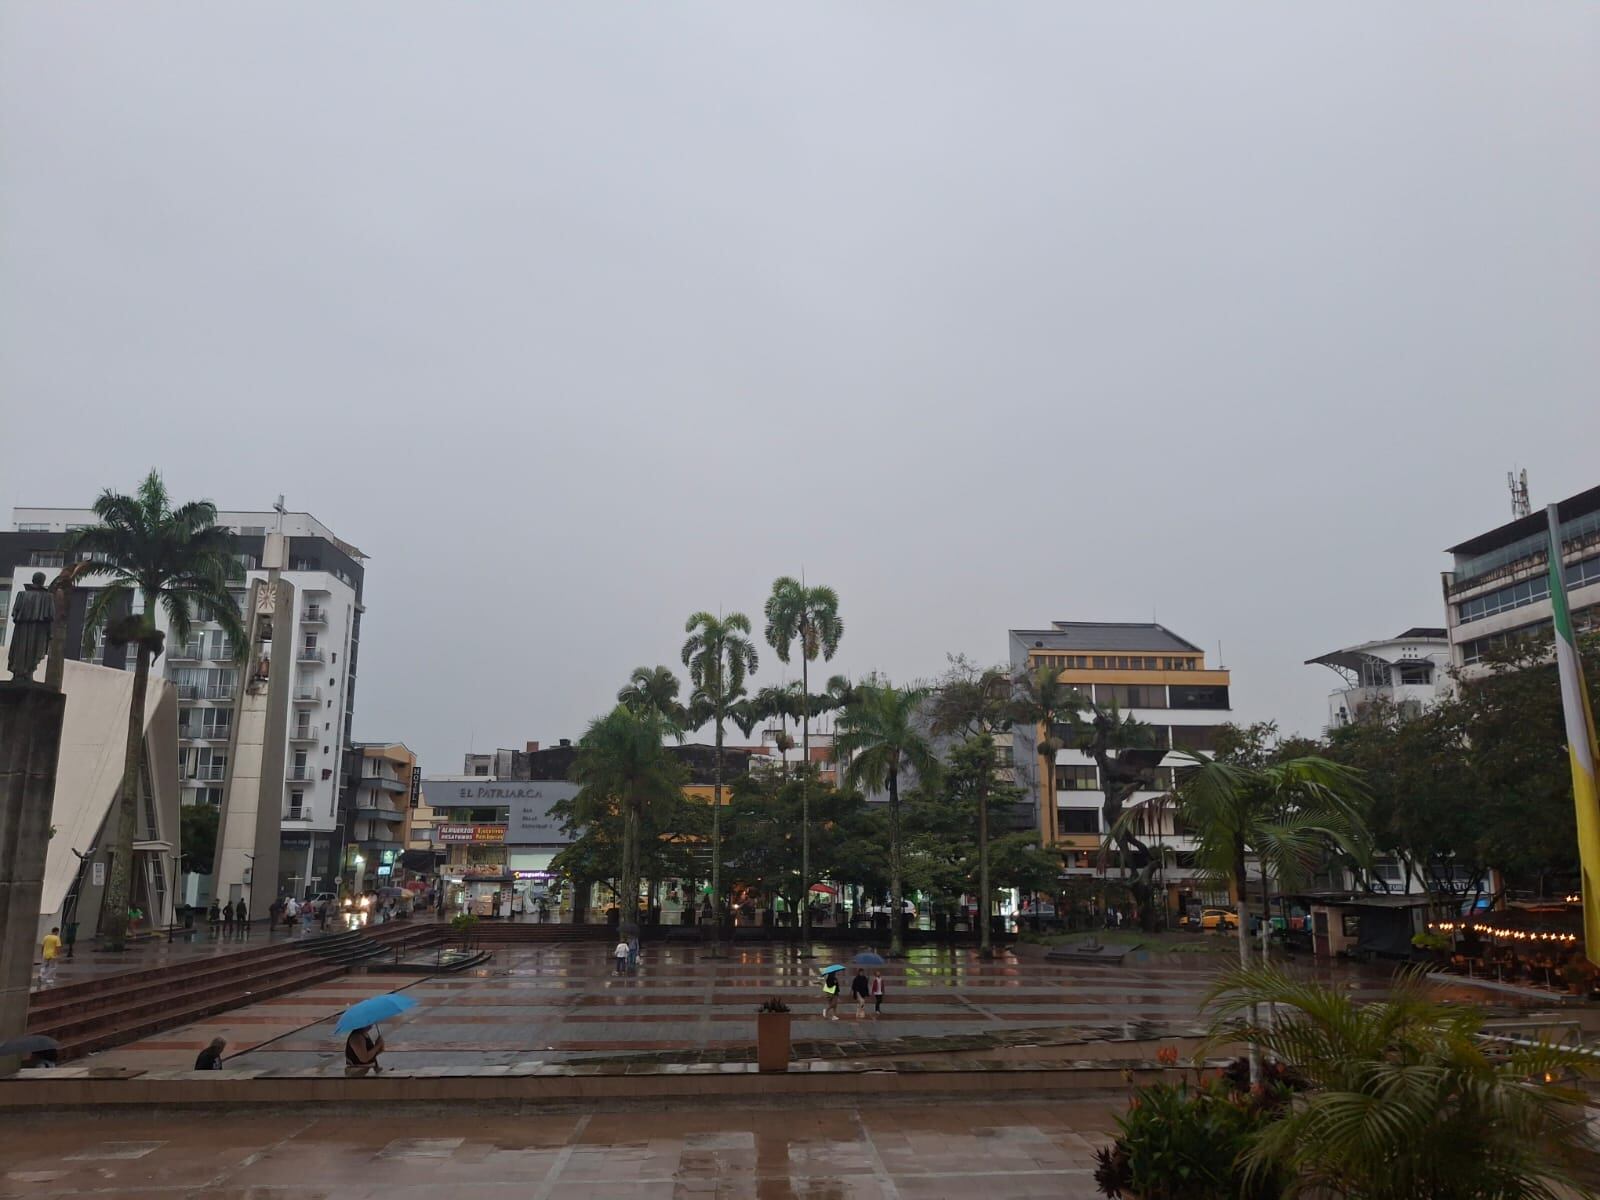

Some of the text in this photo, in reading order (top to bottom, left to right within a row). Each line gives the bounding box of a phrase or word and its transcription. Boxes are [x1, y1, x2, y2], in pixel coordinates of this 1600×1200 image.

[412, 767, 421, 801] HOTEL
[459, 786, 543, 799] EL PATRIARCA
